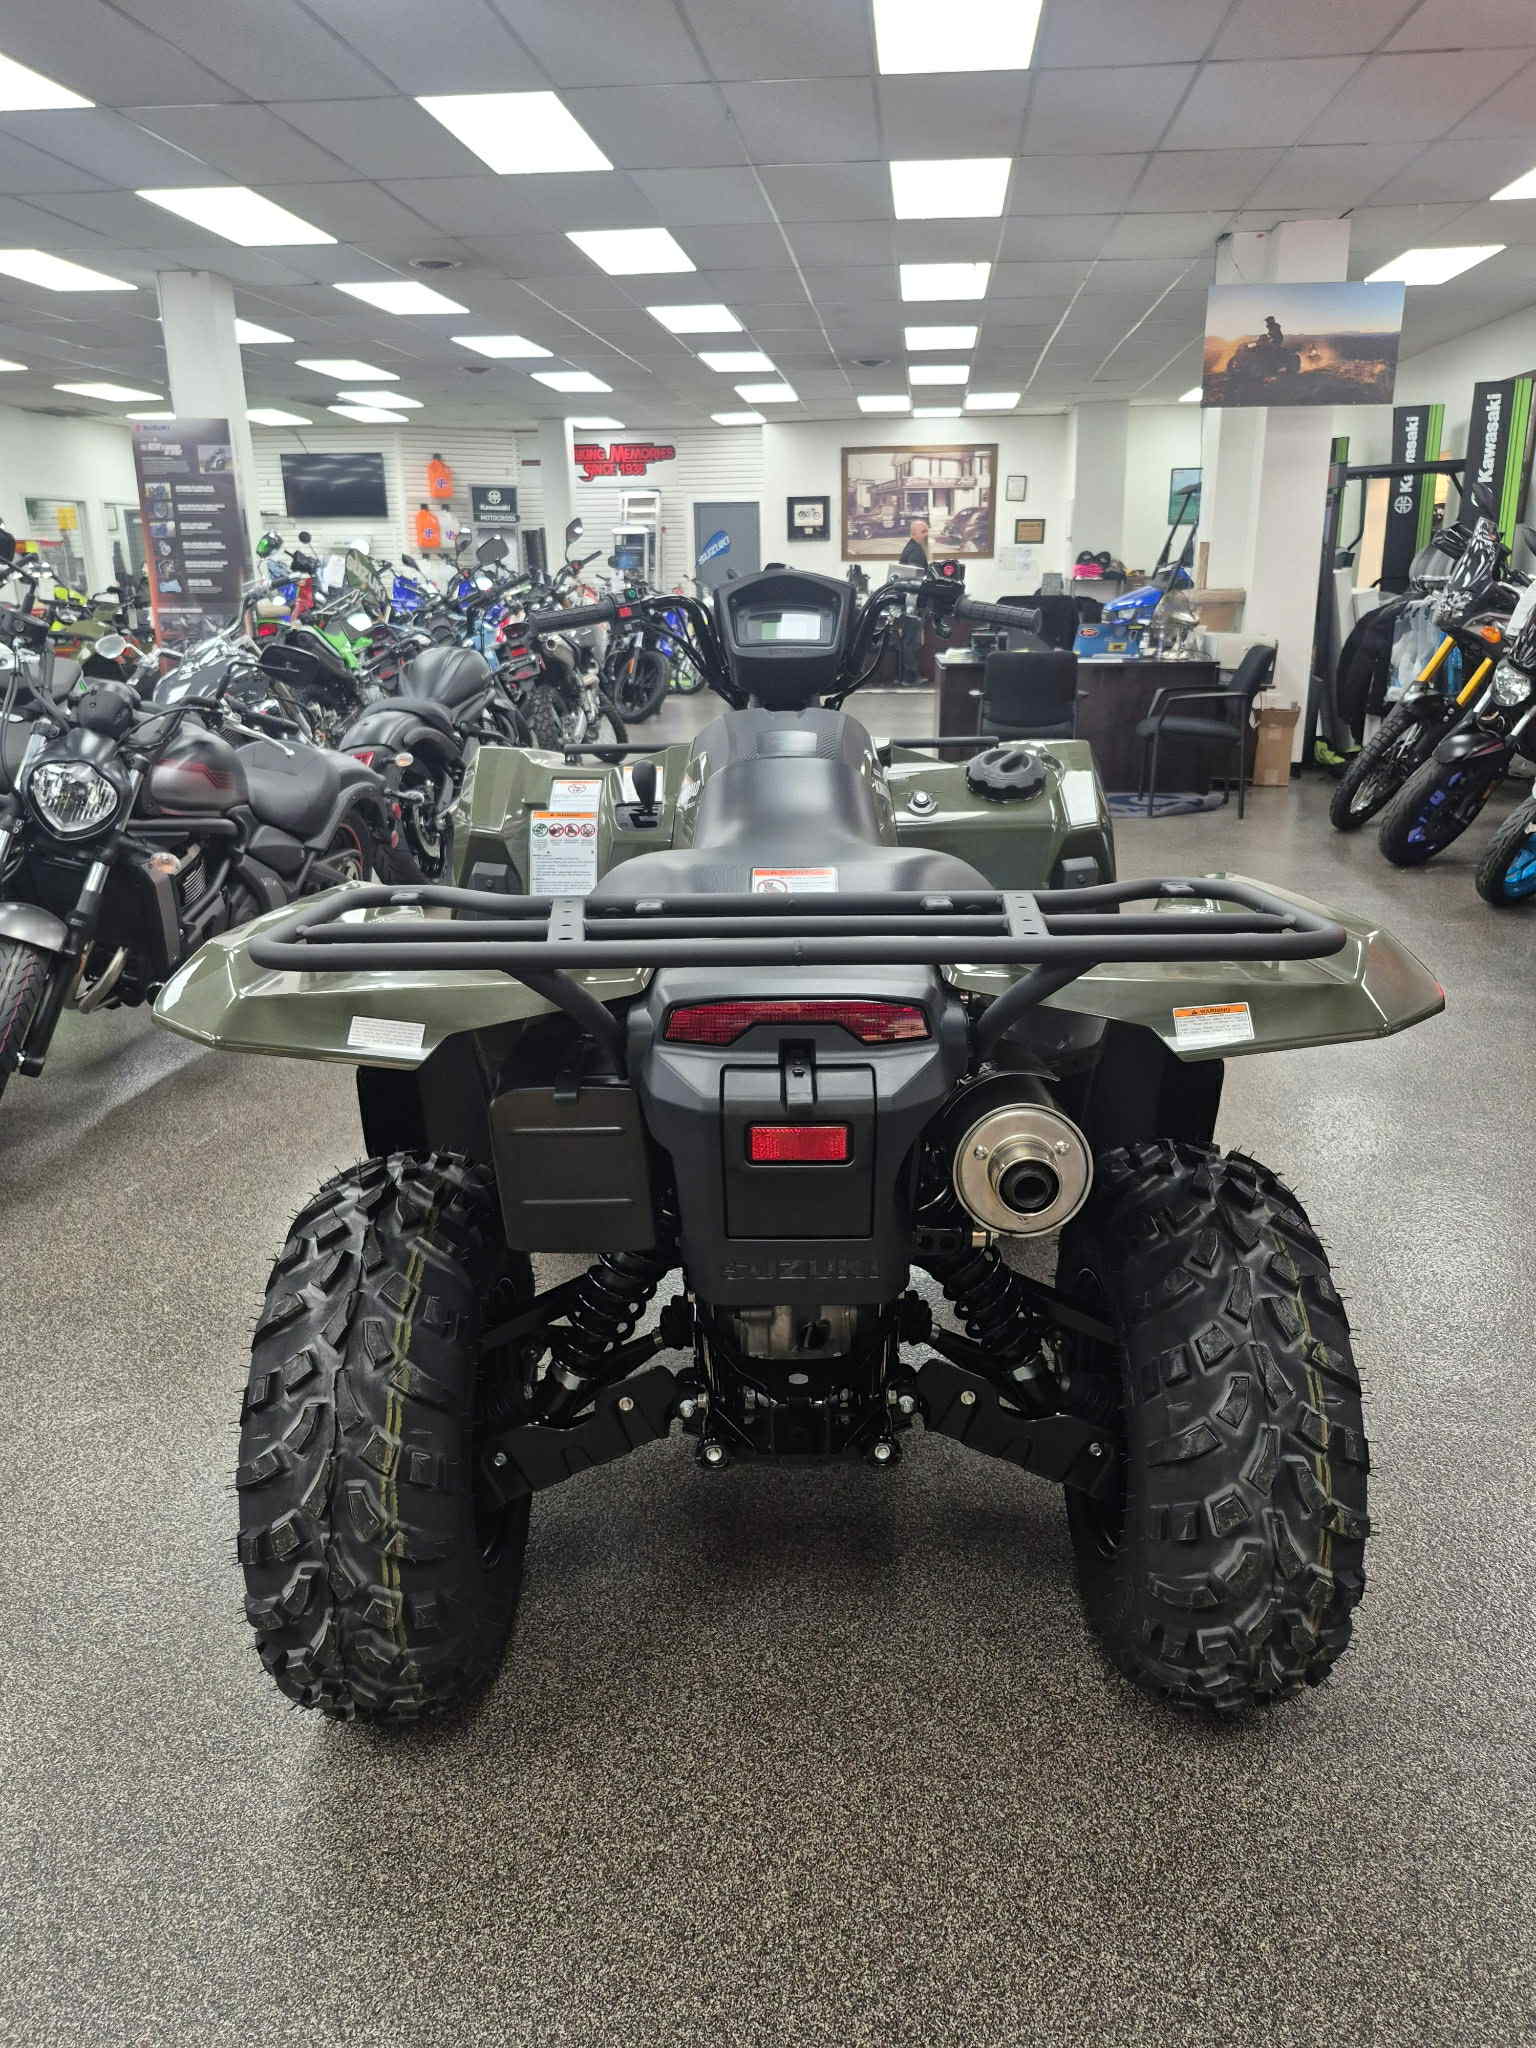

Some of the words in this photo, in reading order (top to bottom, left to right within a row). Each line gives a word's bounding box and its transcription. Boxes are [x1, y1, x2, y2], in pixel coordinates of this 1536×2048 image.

[1477, 393, 1502, 483] Kawasaki
[697, 535, 731, 566] SUZUKI
[721, 1256, 881, 1280] SUZUKI
